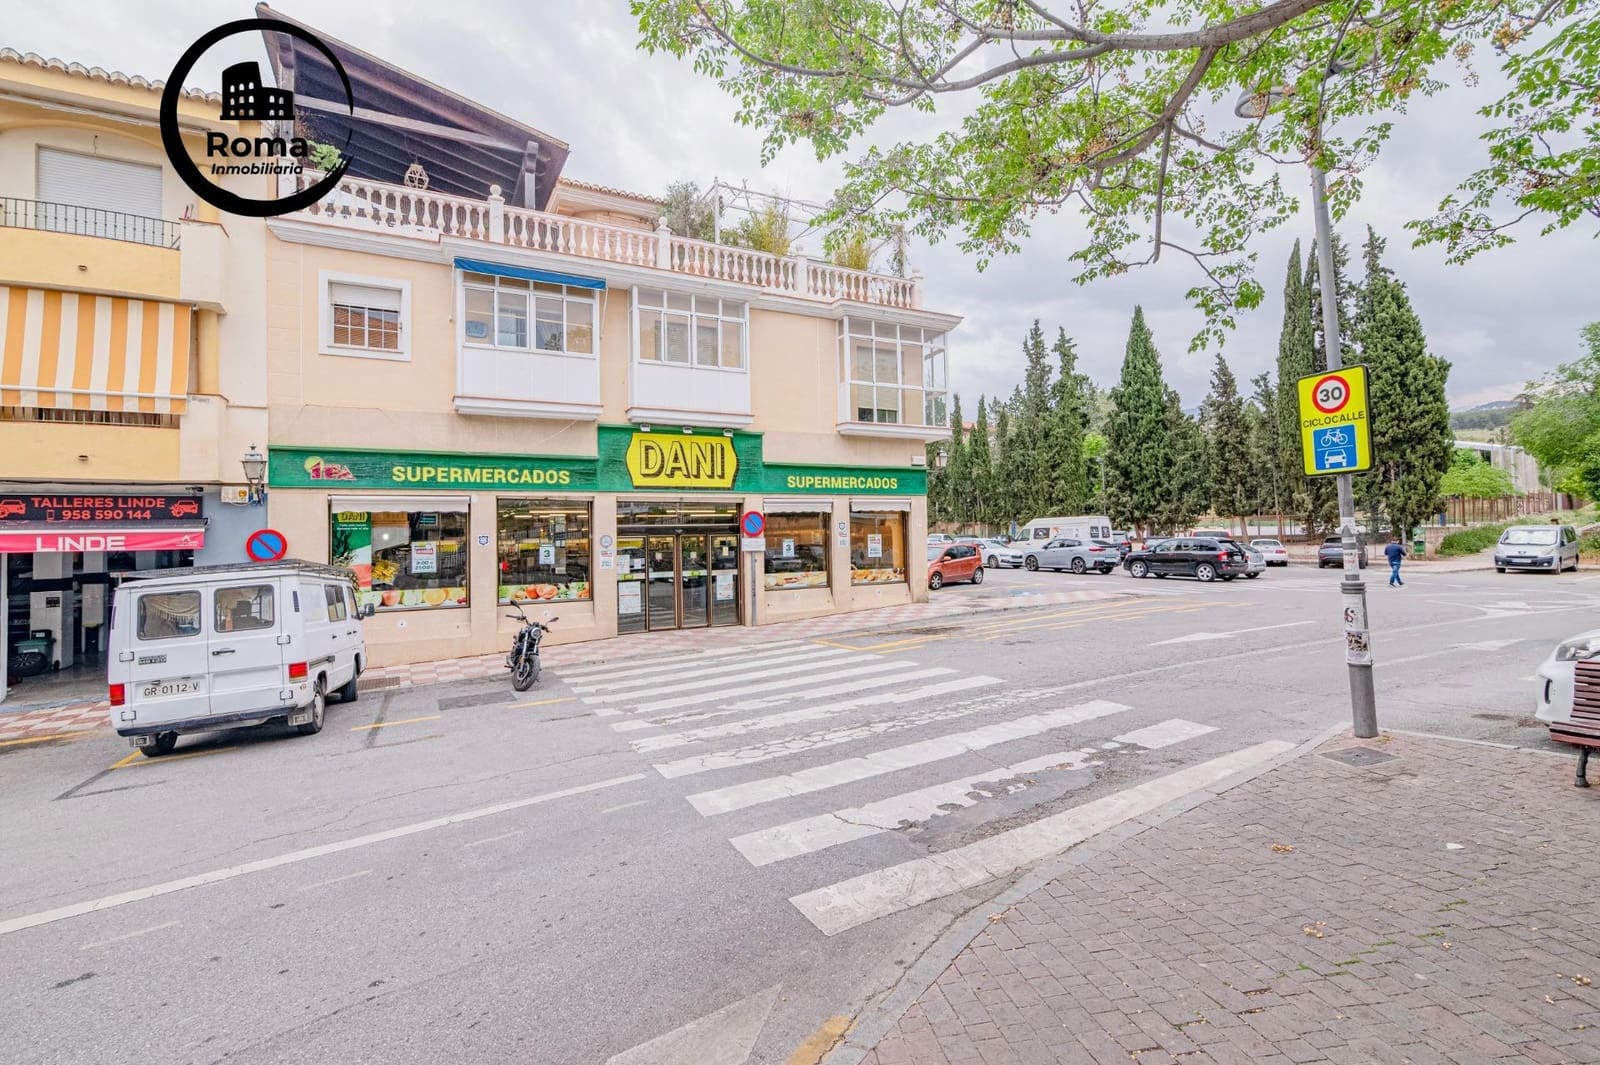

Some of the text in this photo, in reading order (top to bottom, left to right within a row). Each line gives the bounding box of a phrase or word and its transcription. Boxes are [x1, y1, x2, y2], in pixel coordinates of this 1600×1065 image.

[1319, 386, 1343, 402] 30
[1303, 410, 1365, 428] CICLOCALLE
[640, 439, 725, 479] DANI
[392, 466, 570, 484] SUPERMERCADOS
[787, 475, 898, 489] SUPERMERCADOS
[31, 497, 166, 508] TALLERES LINDE
[62, 509, 151, 520] 958 590 144
[36, 536, 126, 552] LINDE
[543, 549, 551, 558] 3
